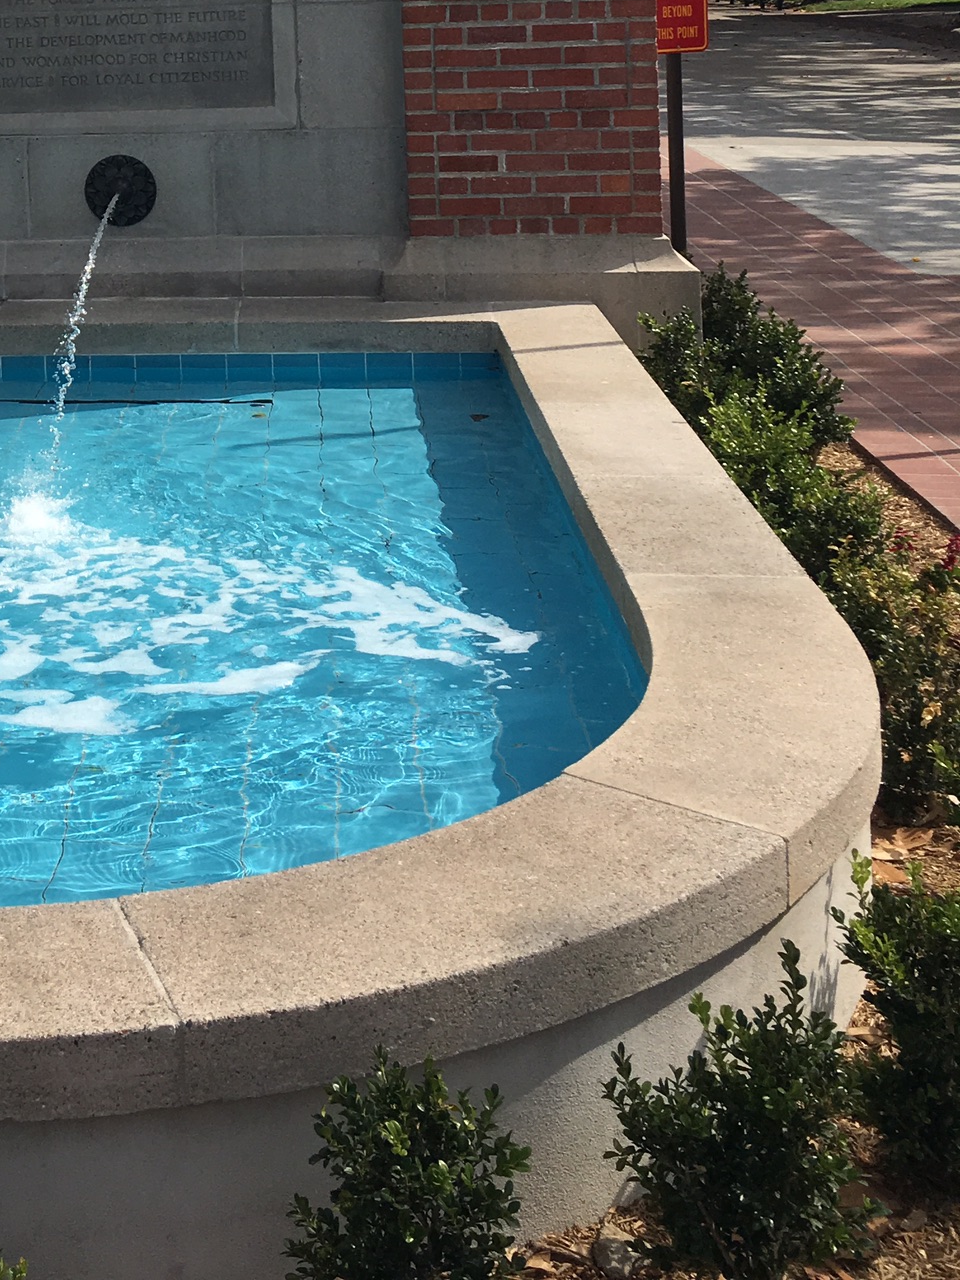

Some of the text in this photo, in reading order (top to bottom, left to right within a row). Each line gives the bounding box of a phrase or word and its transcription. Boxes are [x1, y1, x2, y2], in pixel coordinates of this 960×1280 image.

[15, 16, 49, 28] PAST
[64, 15, 101, 26] WILL
[105, 12, 148, 26] MOLD
[152, 12, 183, 24] THE
[188, 10, 246, 22] FUTURE
[662, 5, 693, 18] BEYOND
[6, 37, 33, 49] THE
[40, 33, 146, 48] DEVELOPMENT
[150, 32, 168, 45] OF
[169, 29, 247, 43] MANHOOD
[677, 25, 698, 39] POINT
[21, 53, 126, 68] WOMANHOOD
[130, 52, 158, 65] FOR
[162, 49, 248, 64] CHRISTIAN
[60, 74, 89, 87] FOR
[95, 72, 145, 85] LOYAL
